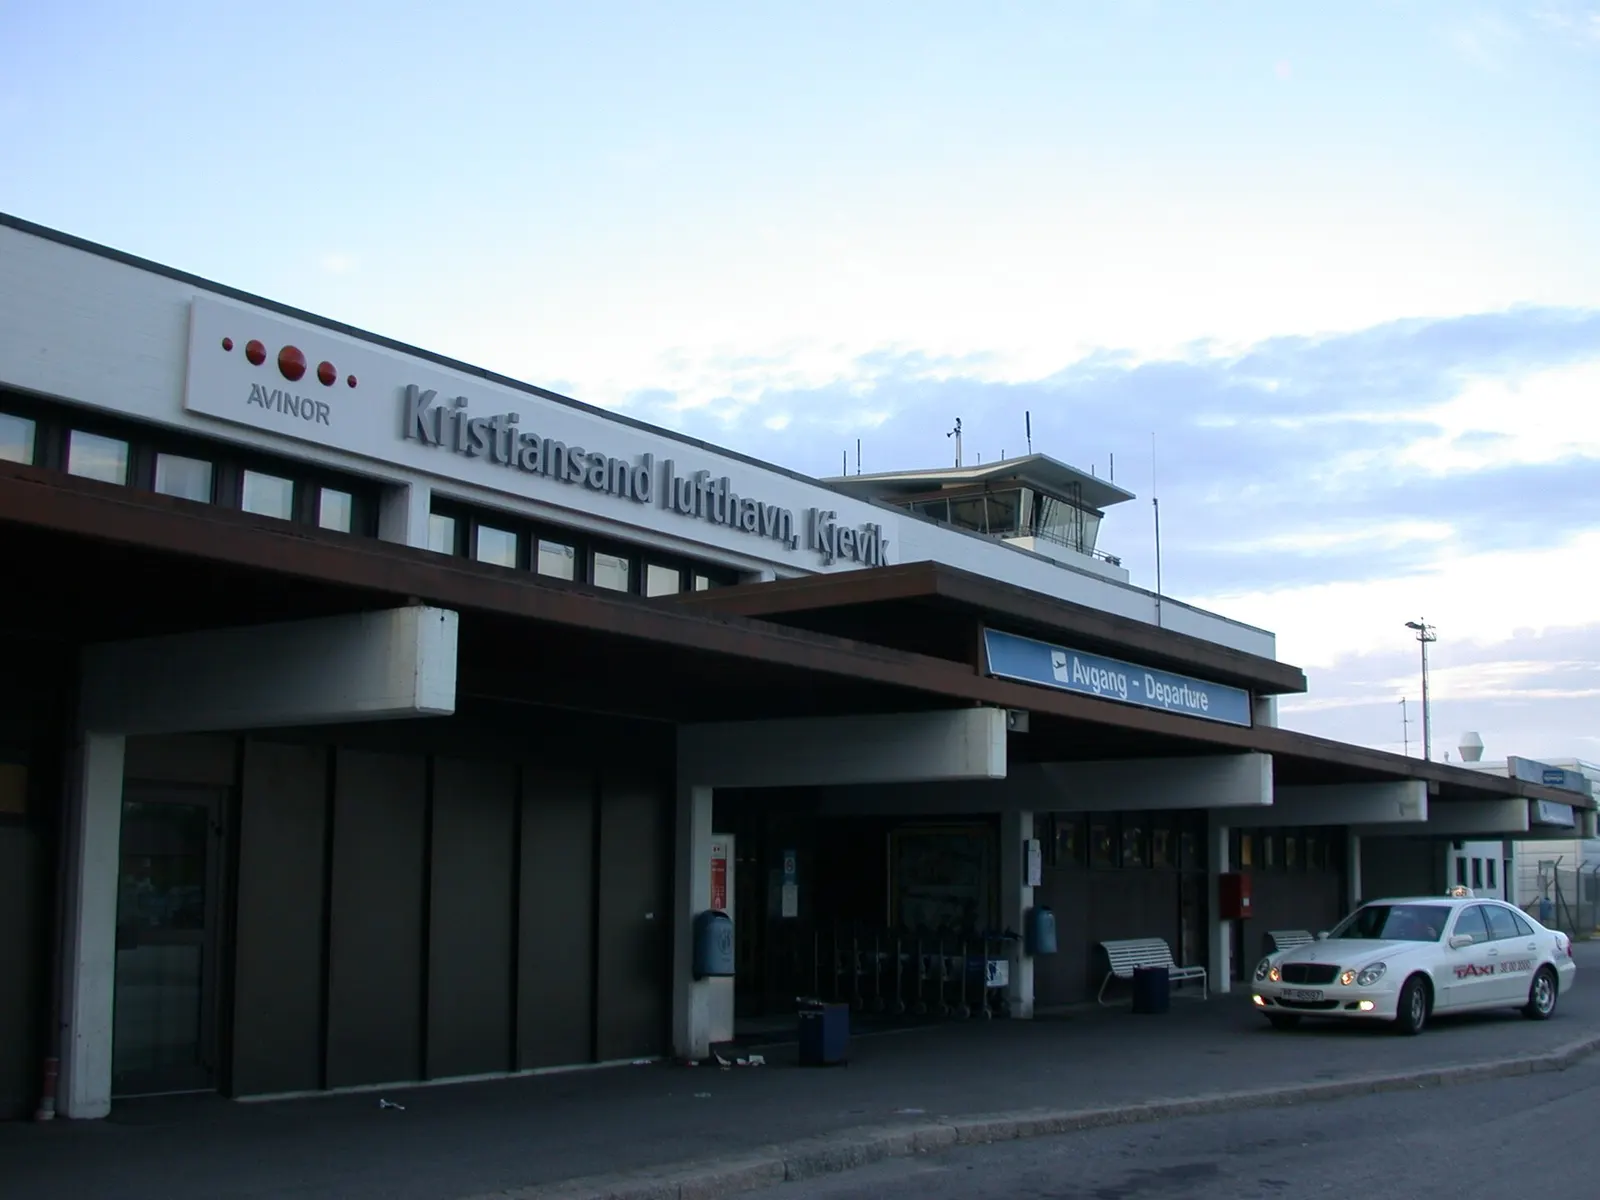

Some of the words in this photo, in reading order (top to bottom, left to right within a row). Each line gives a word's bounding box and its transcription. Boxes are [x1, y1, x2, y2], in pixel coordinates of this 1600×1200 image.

[247, 383, 331, 427] AVINOR
[403, 384, 654, 504] Kristiansand
[662, 459, 801, 550] lufthavn,
[807, 507, 890, 566] Kjevik
[1073, 656, 1127, 700] Avgang
[1145, 673, 1209, 711] Departure
[1454, 963, 1495, 979] TAXI
